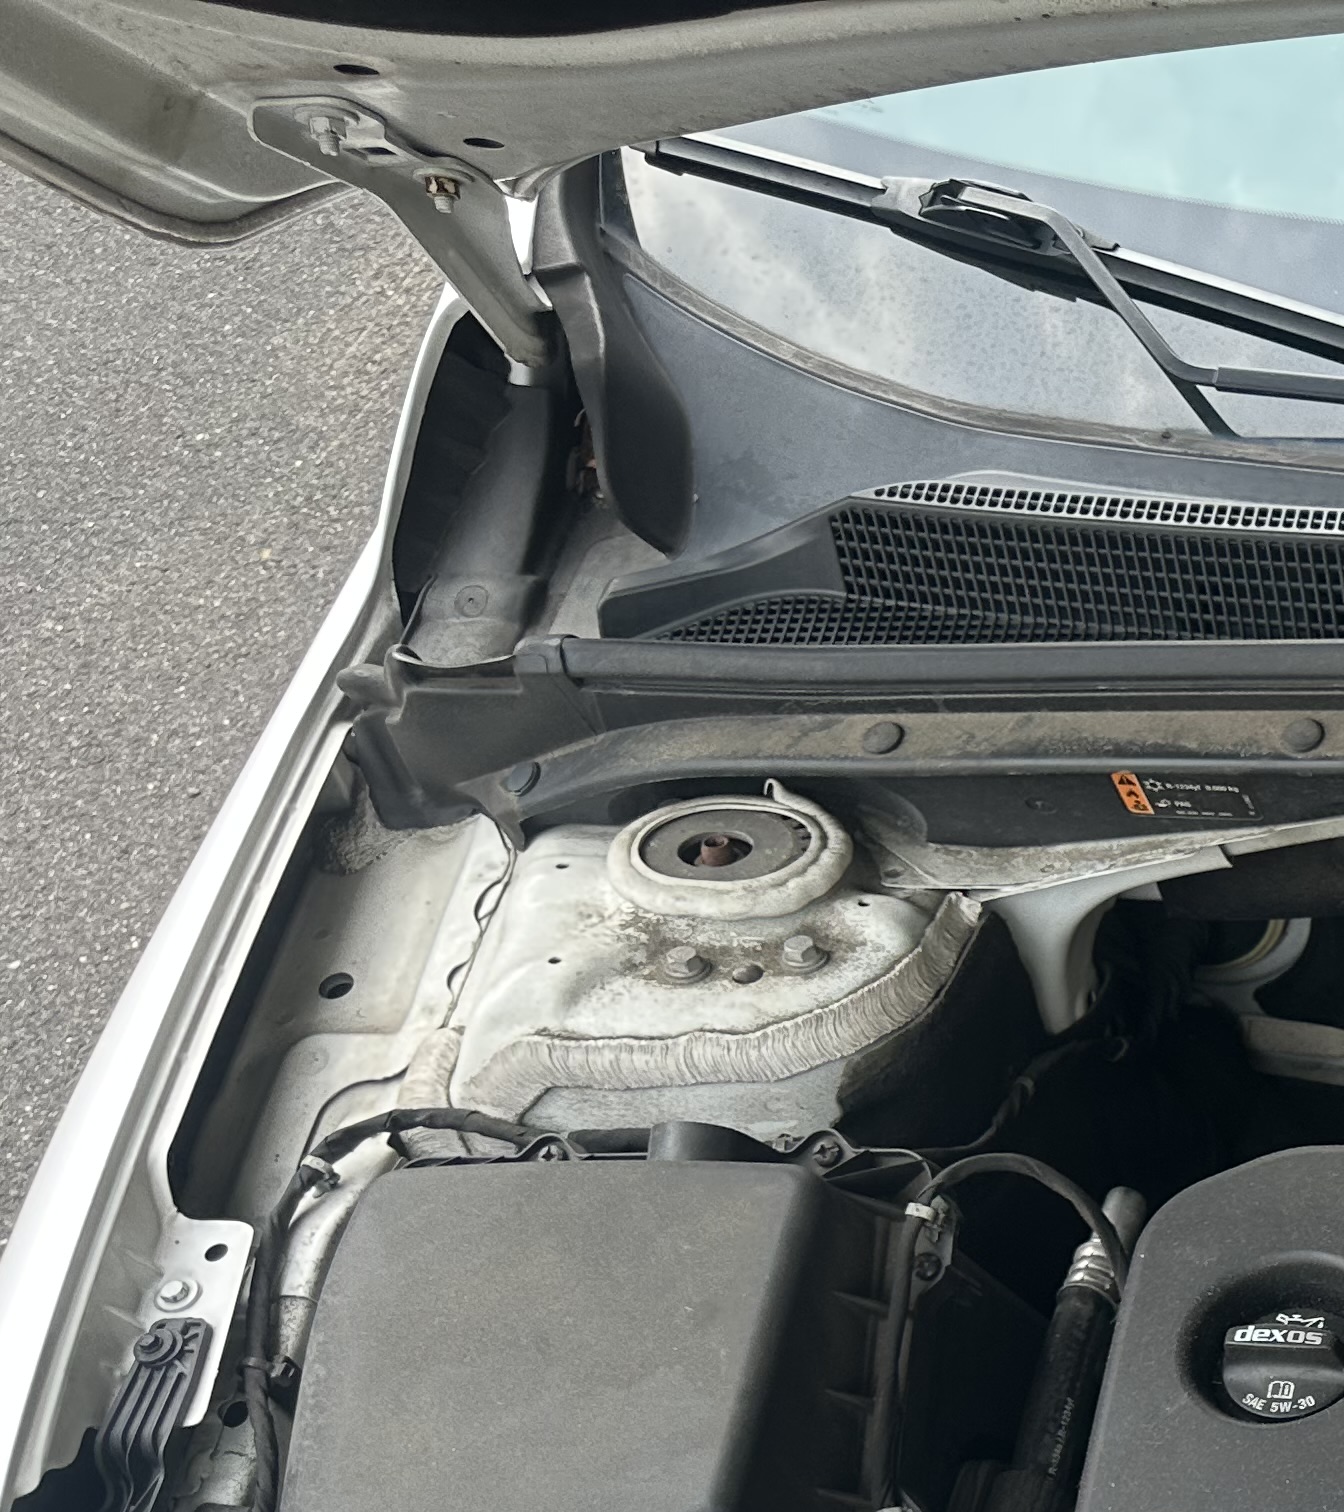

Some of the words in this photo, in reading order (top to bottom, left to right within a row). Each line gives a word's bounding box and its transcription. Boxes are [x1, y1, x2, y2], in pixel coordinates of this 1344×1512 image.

[1234, 1325, 1323, 1346] dexos
[1242, 1394, 1268, 1411] SAE
[1270, 1395, 1316, 1413] 5W-30
